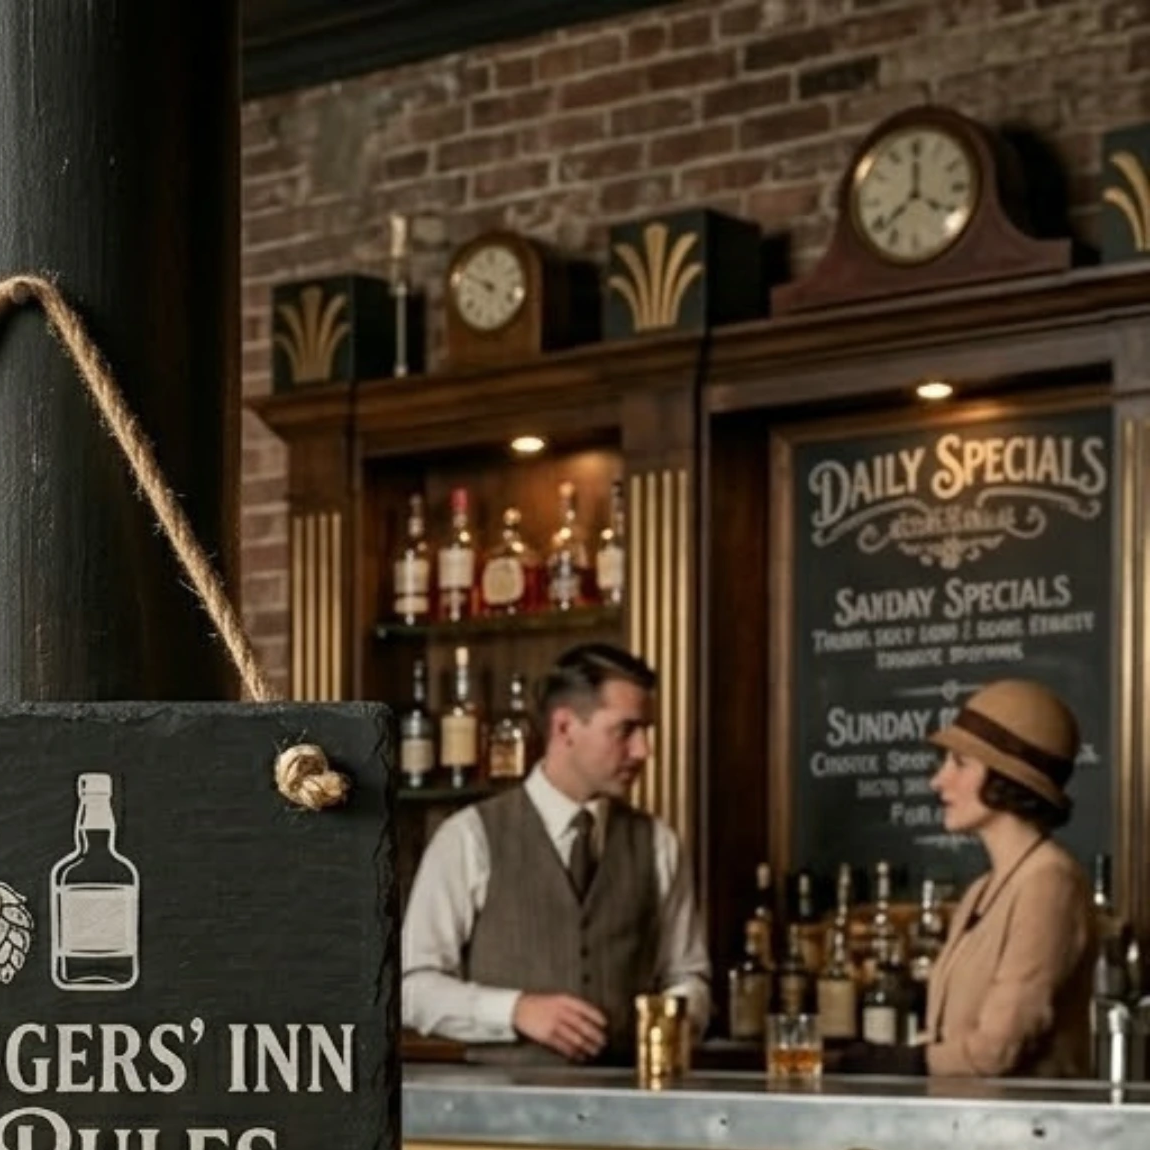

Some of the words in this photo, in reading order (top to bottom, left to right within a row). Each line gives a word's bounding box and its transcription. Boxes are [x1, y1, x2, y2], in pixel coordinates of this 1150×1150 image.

[808, 446, 926, 530] DAILY
[931, 433, 1107, 500] SPECIALS
[943, 574, 1072, 620] SPECIALS
[826, 706, 932, 748] SUNDAY
[228, 1023, 355, 1093] INN
